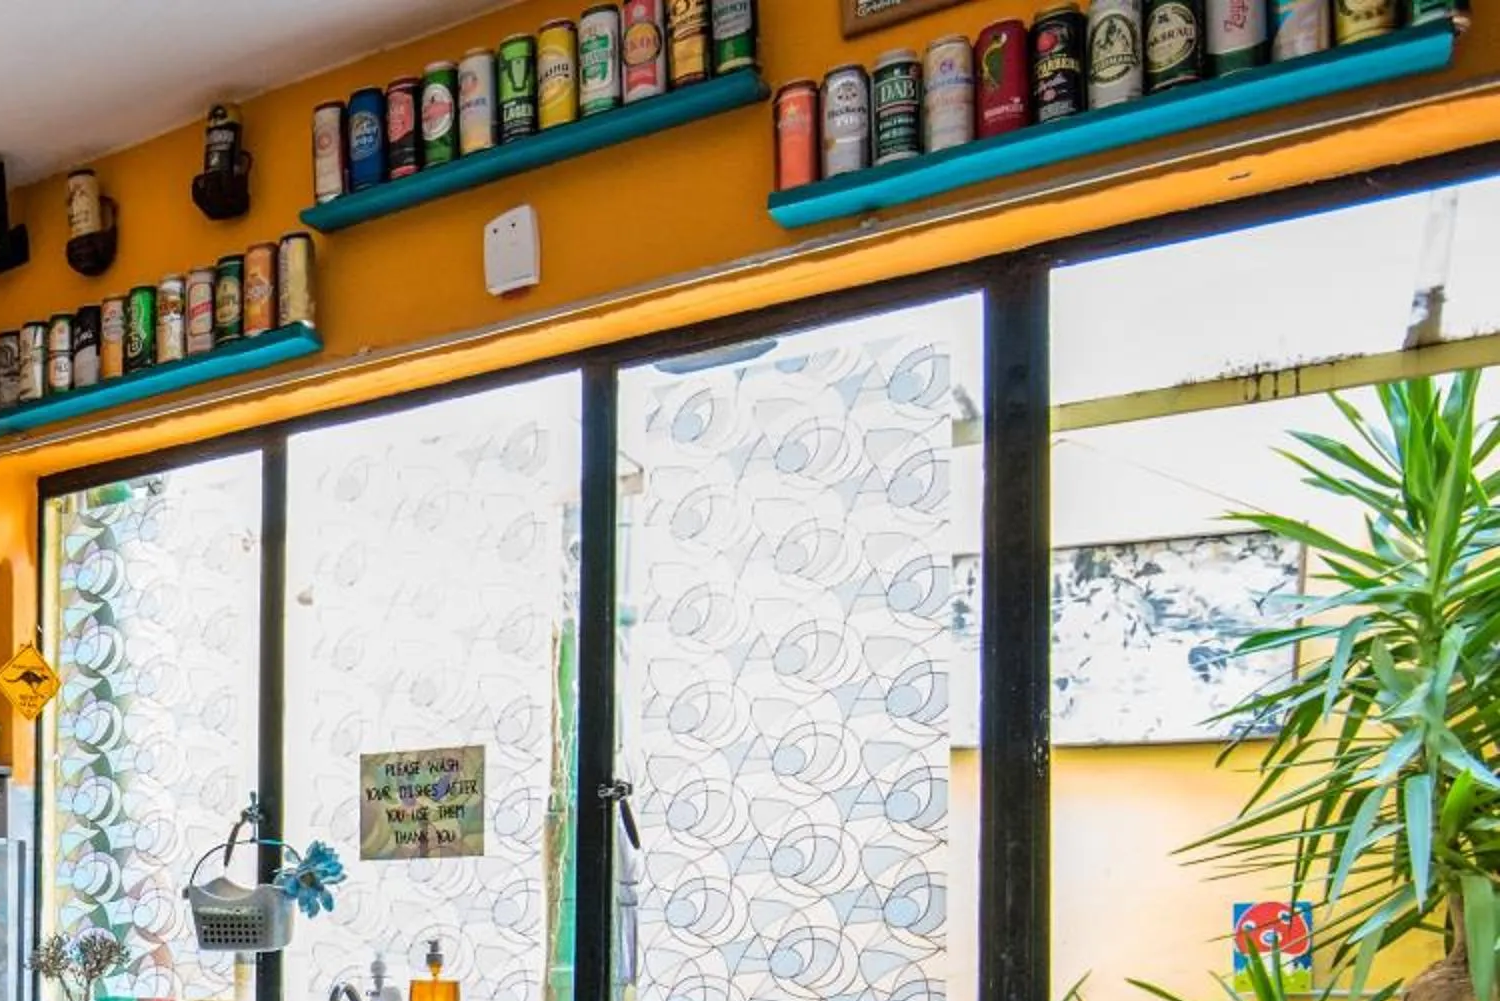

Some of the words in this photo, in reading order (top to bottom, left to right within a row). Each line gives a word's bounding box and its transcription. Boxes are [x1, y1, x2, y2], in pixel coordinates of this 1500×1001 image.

[881, 79, 916, 102] DAB
[385, 761, 420, 777] PLEASE
[428, 758, 459, 775] WASH
[365, 785, 393, 801] YOUR
[437, 804, 466, 820] THEM
[395, 829, 429, 845] THANK
[435, 829, 457, 845] YOU
